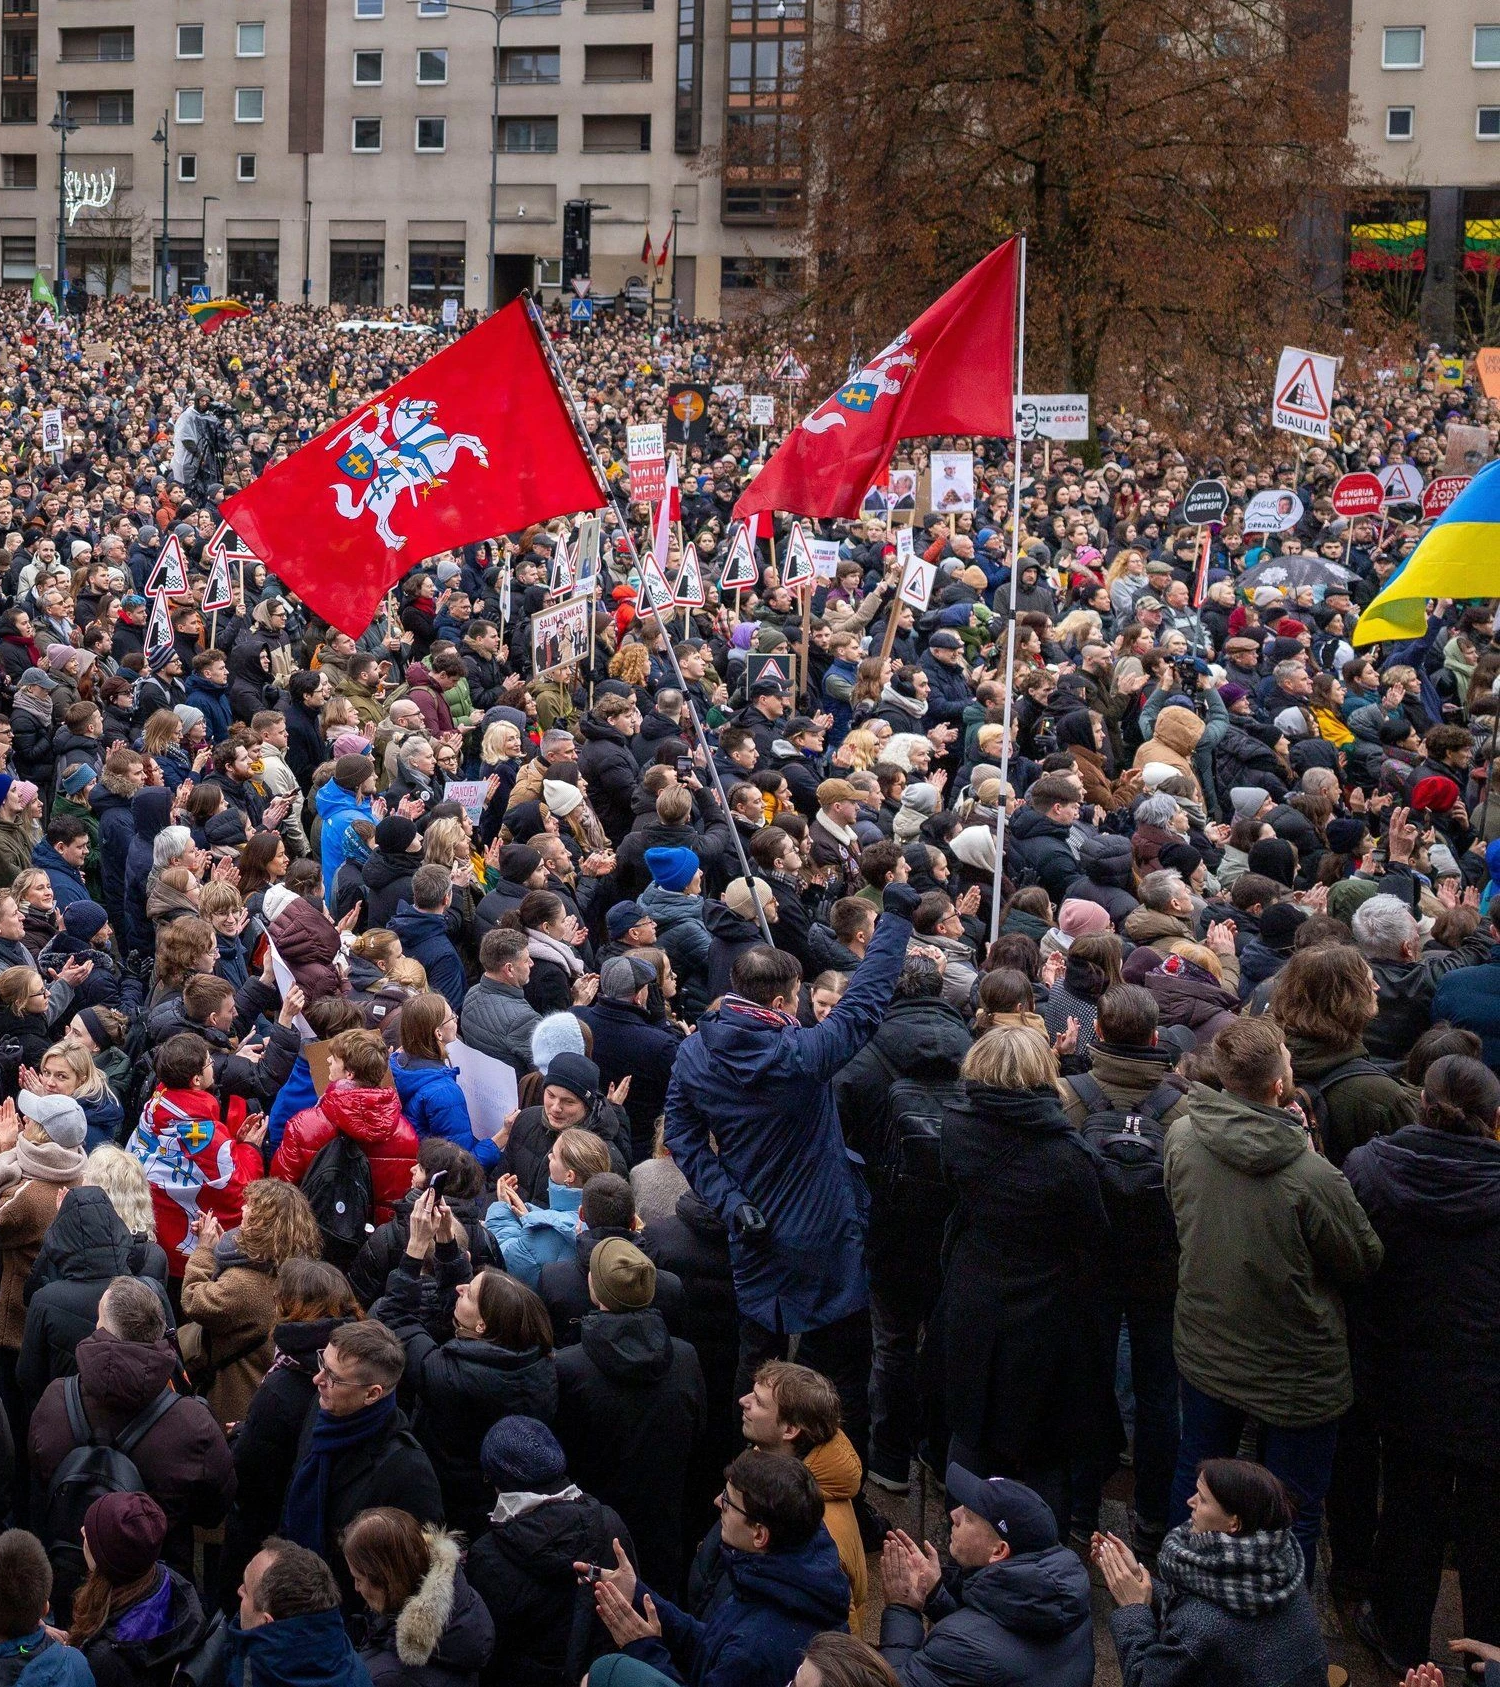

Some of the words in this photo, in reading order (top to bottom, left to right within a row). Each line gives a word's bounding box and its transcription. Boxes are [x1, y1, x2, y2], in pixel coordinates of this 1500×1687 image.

[1039, 404, 1087, 412] NAUSĖDA,
[1054, 415, 1086, 423] GĖDA?
[1277, 411, 1326, 436] ŠIAULIAI
[631, 442, 662, 457] LAISVĘ
[634, 484, 666, 500] MEDIA
[1191, 492, 1222, 502] SLOVAKIJA
[1340, 488, 1374, 498] VENGRIJA
[1252, 500, 1276, 509] PIGUS
[1247, 522, 1282, 530] ORBANAS
[558, 604, 584, 620] RANKAS
